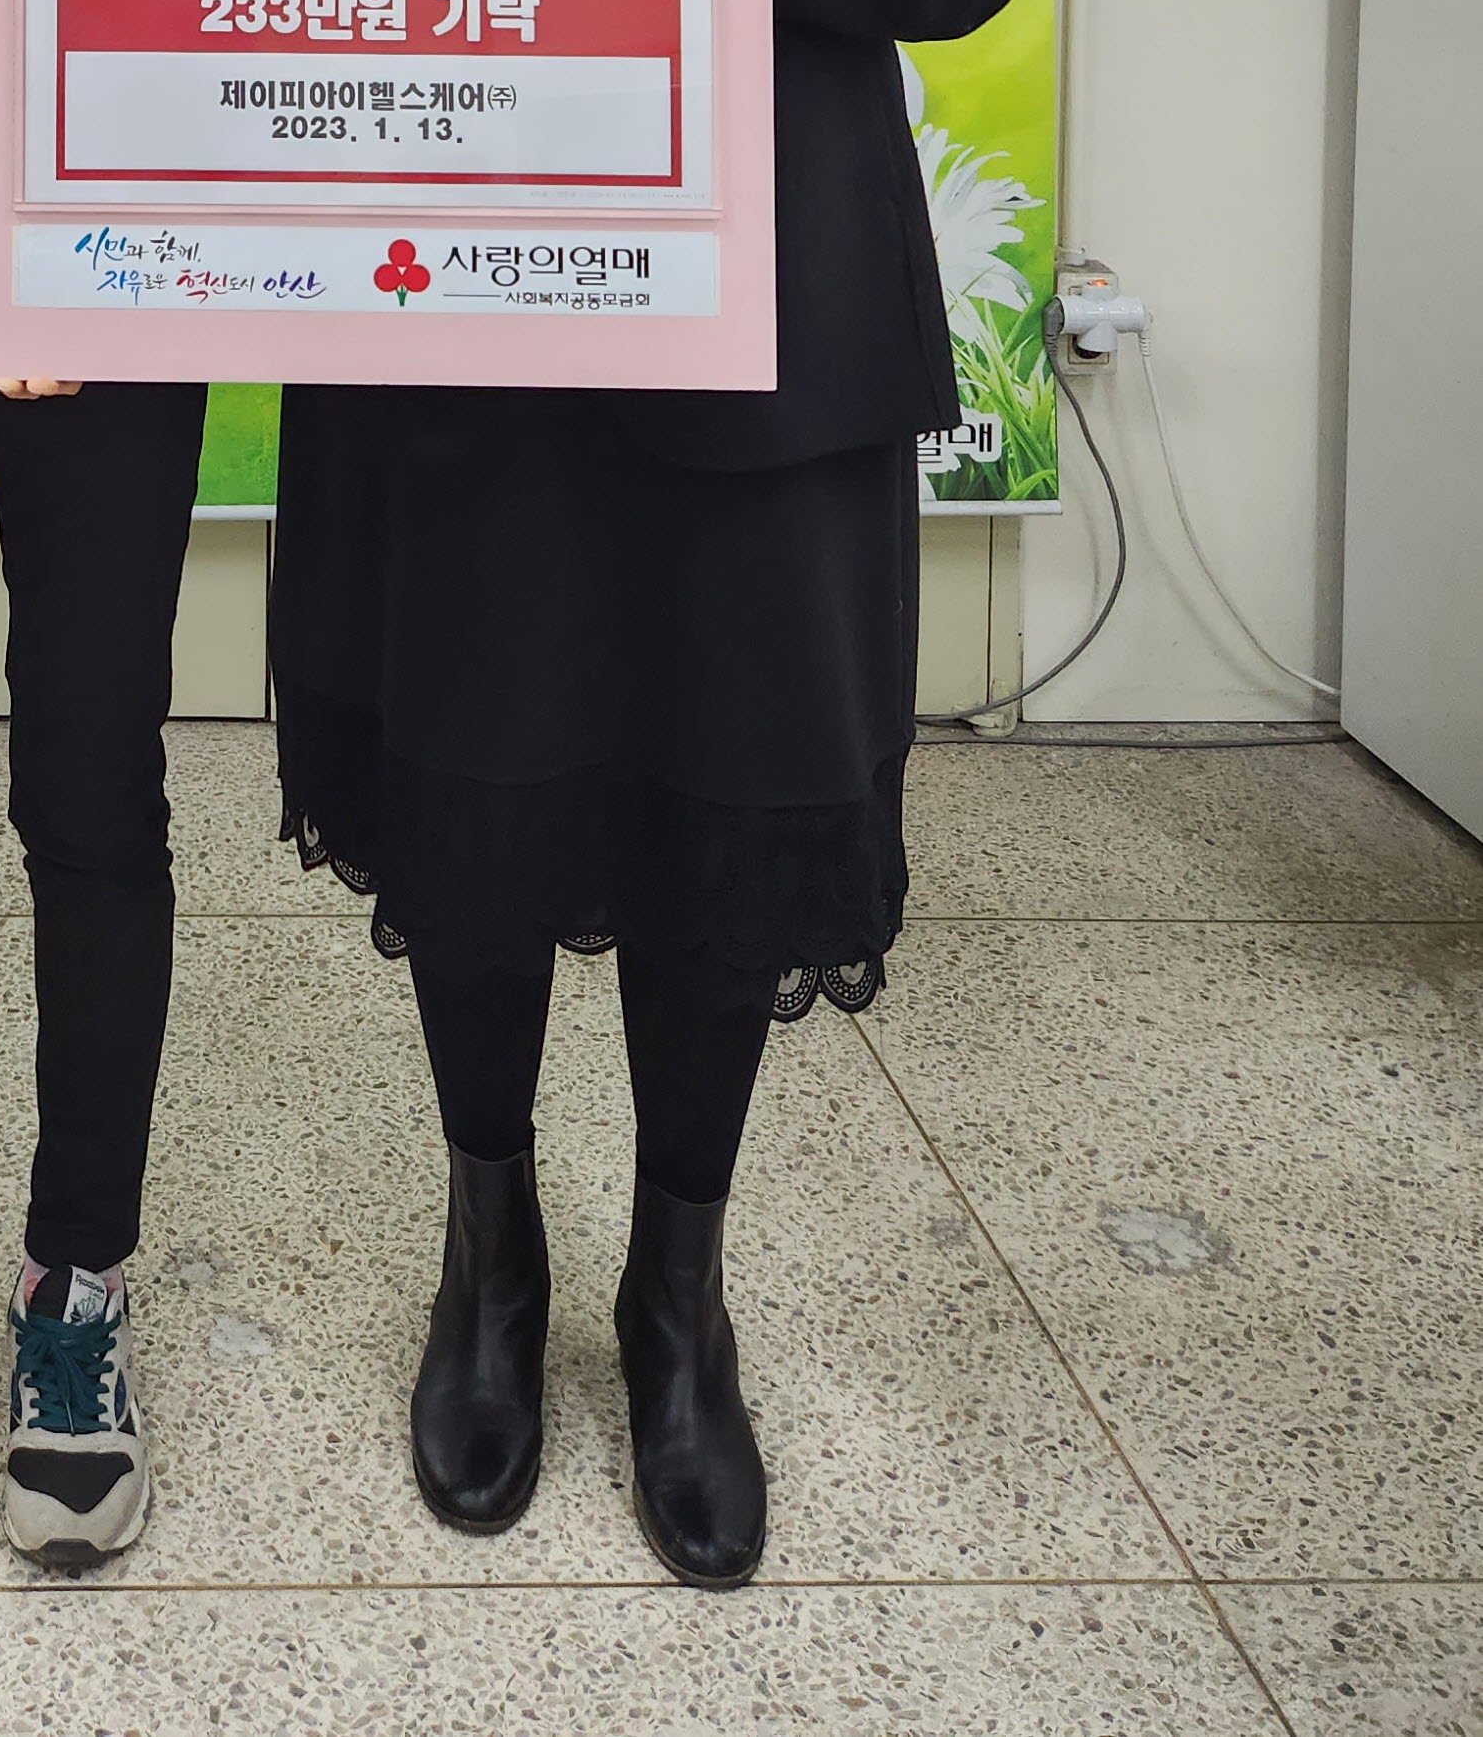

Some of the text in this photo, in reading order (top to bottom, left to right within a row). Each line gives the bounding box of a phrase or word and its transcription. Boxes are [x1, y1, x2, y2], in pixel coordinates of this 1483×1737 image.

[271, 115, 463, 144] 2023. 1. 13.
[74, 226, 149, 271] 시민과
[442, 245, 650, 287] 사랑의열매
[96, 268, 328, 306] 자유로운 혁신도시 안산
[504, 291, 651, 310] 사회복지공동모금회
